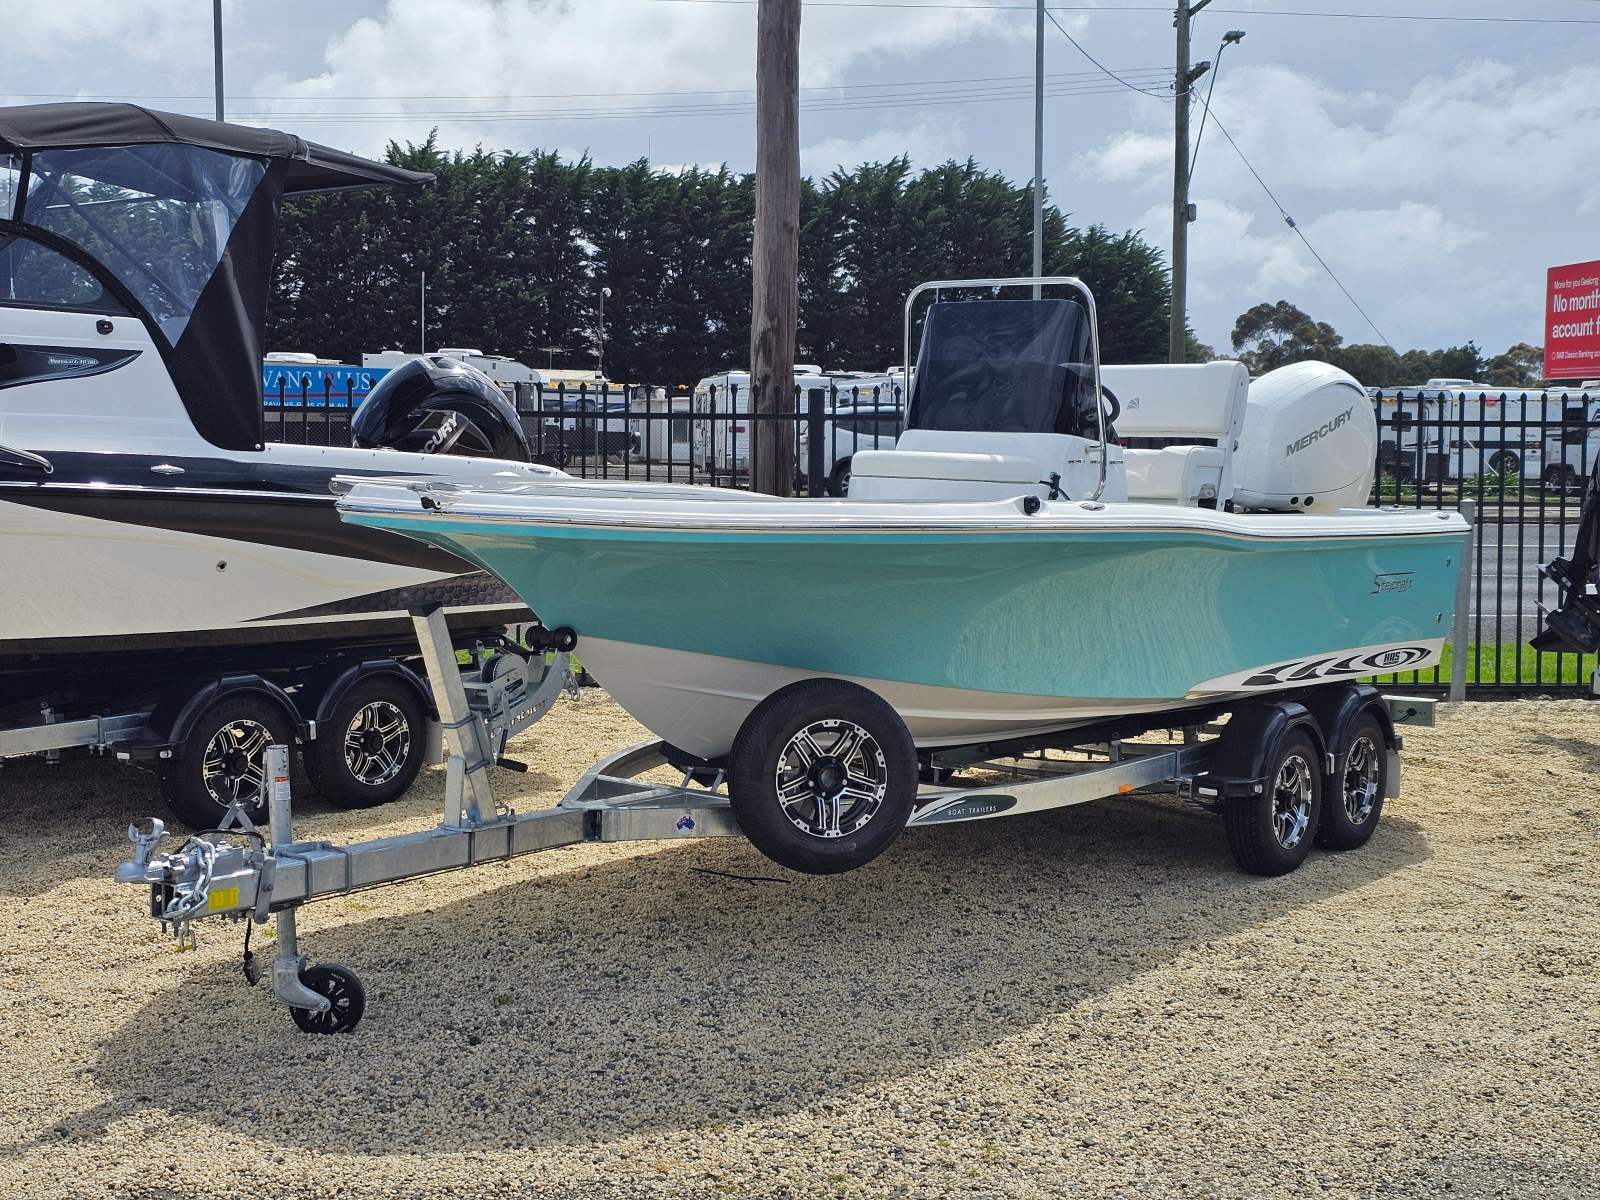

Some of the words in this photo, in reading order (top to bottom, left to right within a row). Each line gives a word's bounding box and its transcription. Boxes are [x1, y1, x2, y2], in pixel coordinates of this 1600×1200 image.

[1553, 294, 1568, 313] No
[1552, 318, 1594, 338] account
[417, 411, 458, 454] CURY
[1285, 406, 1354, 457] MERCURY
[948, 808, 966, 816] BOAT
[968, 805, 997, 814] TRAILERS
